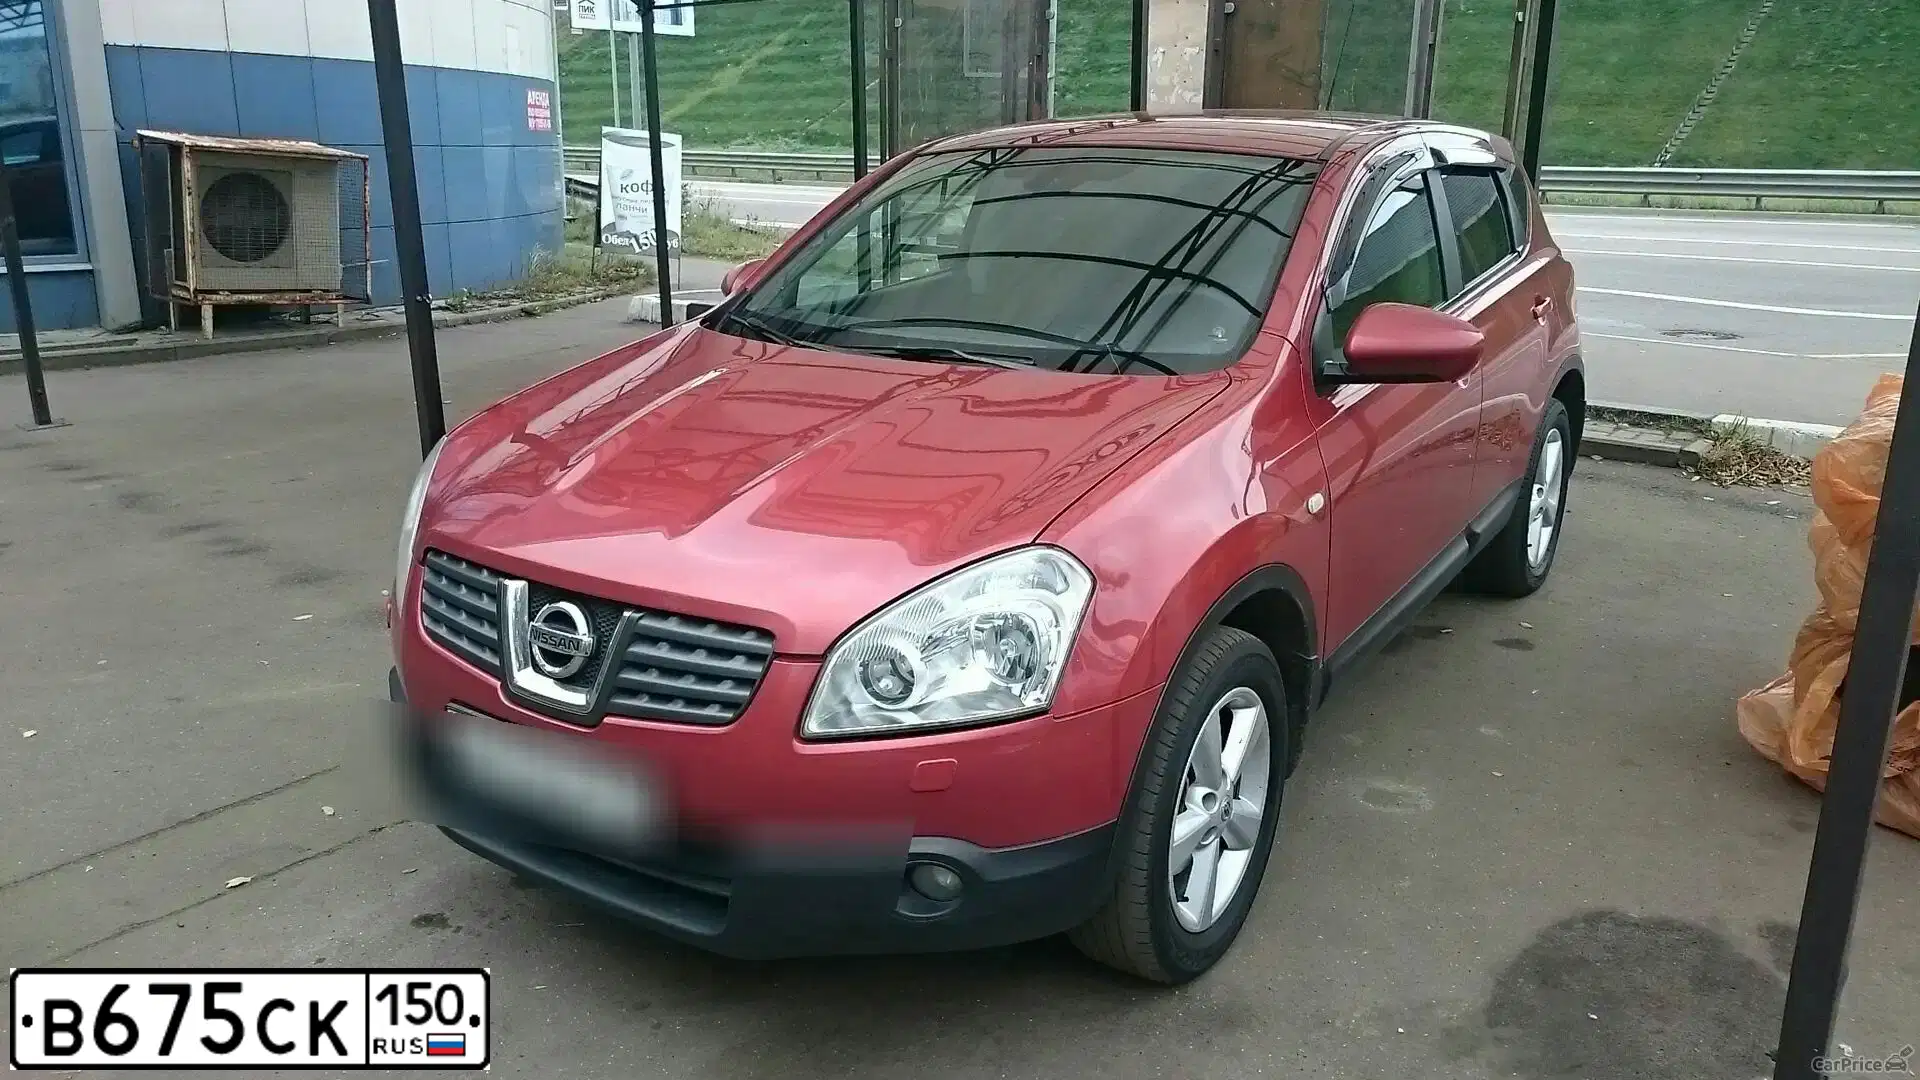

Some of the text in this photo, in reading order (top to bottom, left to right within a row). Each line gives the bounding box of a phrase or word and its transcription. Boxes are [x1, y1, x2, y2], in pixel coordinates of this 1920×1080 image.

[578, 4, 595, 14] ПИК
[527, 90, 550, 108] АРЕНДА
[620, 180, 665, 195] коф
[601, 233, 630, 247] Обед
[530, 628, 580, 652] NISSAN
